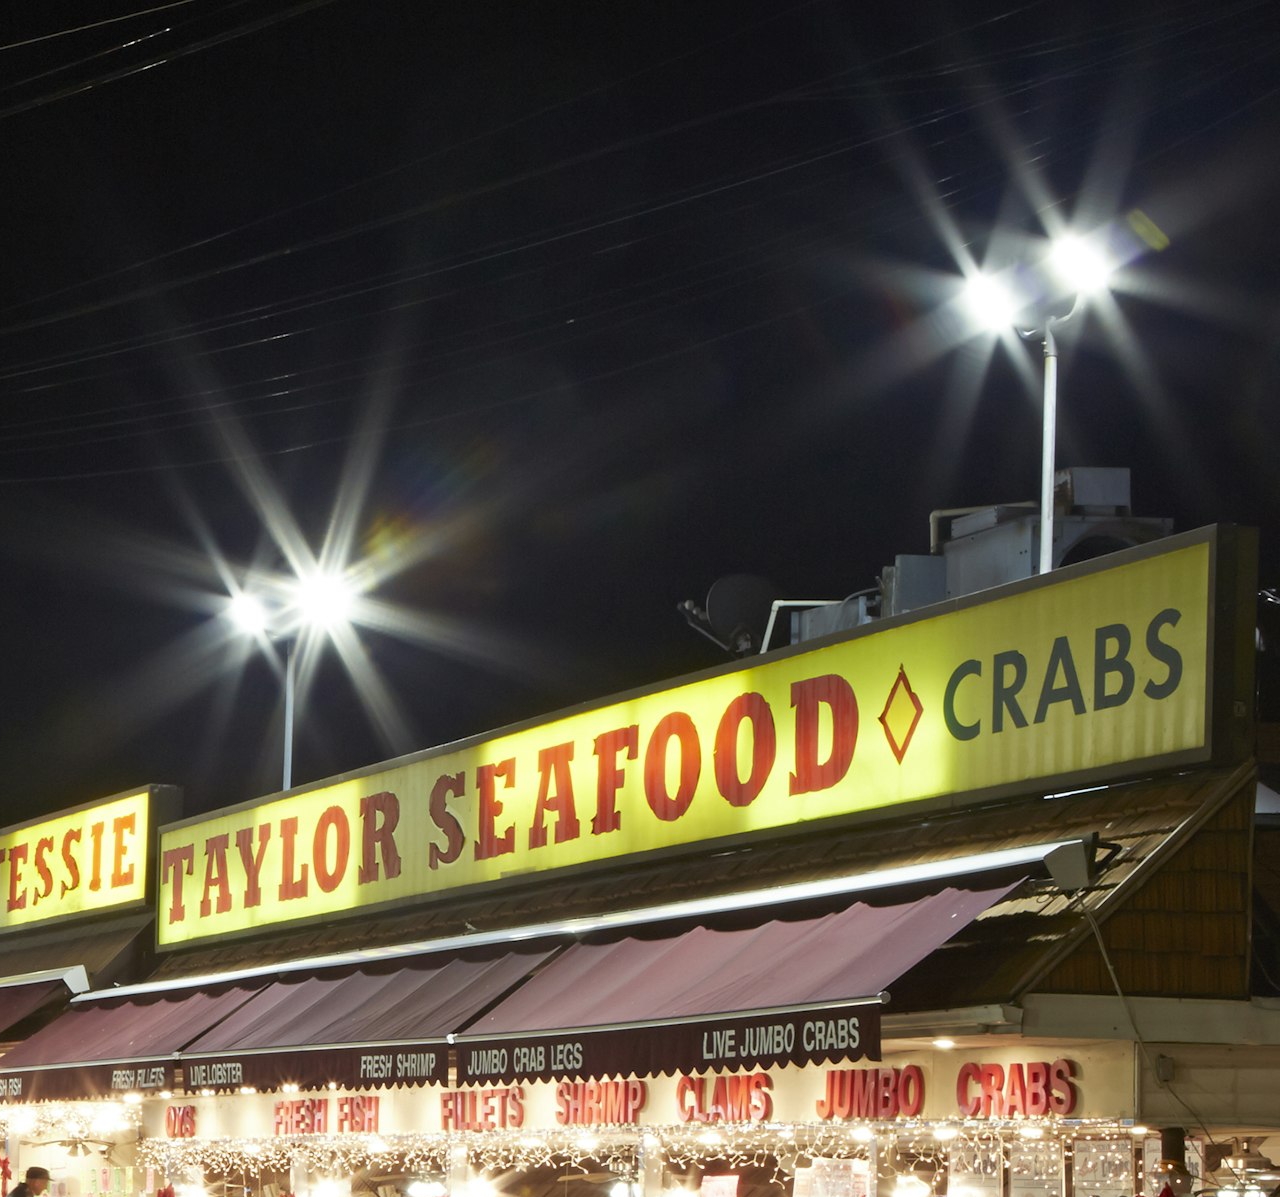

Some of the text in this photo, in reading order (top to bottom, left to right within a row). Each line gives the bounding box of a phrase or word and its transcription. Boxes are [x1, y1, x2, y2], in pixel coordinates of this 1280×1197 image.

[161, 605, 1184, 924] TAYLOR SEAFOOD CRABS
[467, 1042, 584, 1075] JUMBO CRAB LEGS
[702, 1017, 860, 1060] LIVE JUMBO CRABS
[111, 1066, 165, 1090] FRESH FILLETS
[189, 1062, 243, 1086] LIVE LOBSTER
[360, 1052, 437, 1079] FRESH SHRIMP
[440, 1085, 525, 1131] FILLETS
[555, 1078, 646, 1126] SHRIMP
[676, 1072, 774, 1123] CLAMS
[816, 1063, 926, 1119] JUMBO
[956, 1058, 1078, 1118] CRABS
[165, 1104, 197, 1138] OYS
[273, 1095, 380, 1136] FRESH FISH
